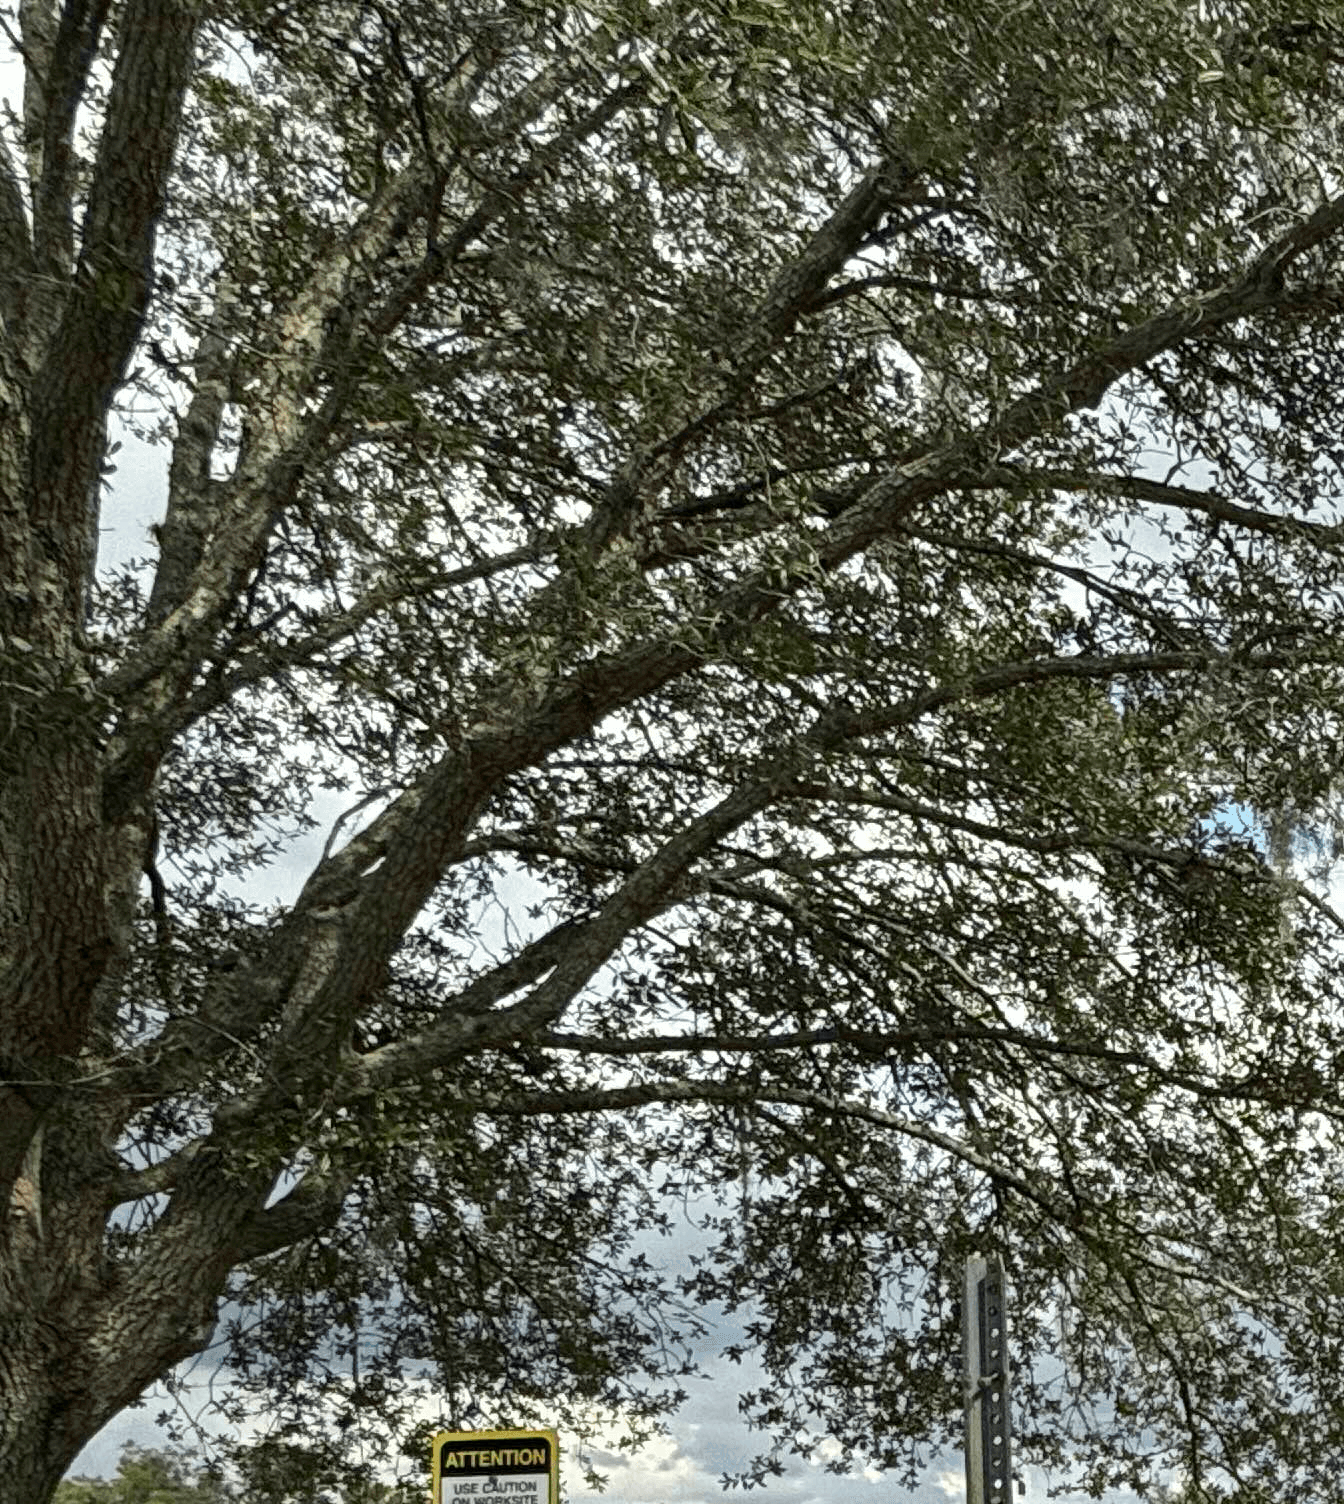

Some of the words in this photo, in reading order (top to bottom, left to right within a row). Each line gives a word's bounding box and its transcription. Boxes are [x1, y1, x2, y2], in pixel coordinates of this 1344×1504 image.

[445, 1448, 546, 1468] ATTENTION
[454, 1483, 478, 1495] USE
[483, 1481, 537, 1494] CAUTION
